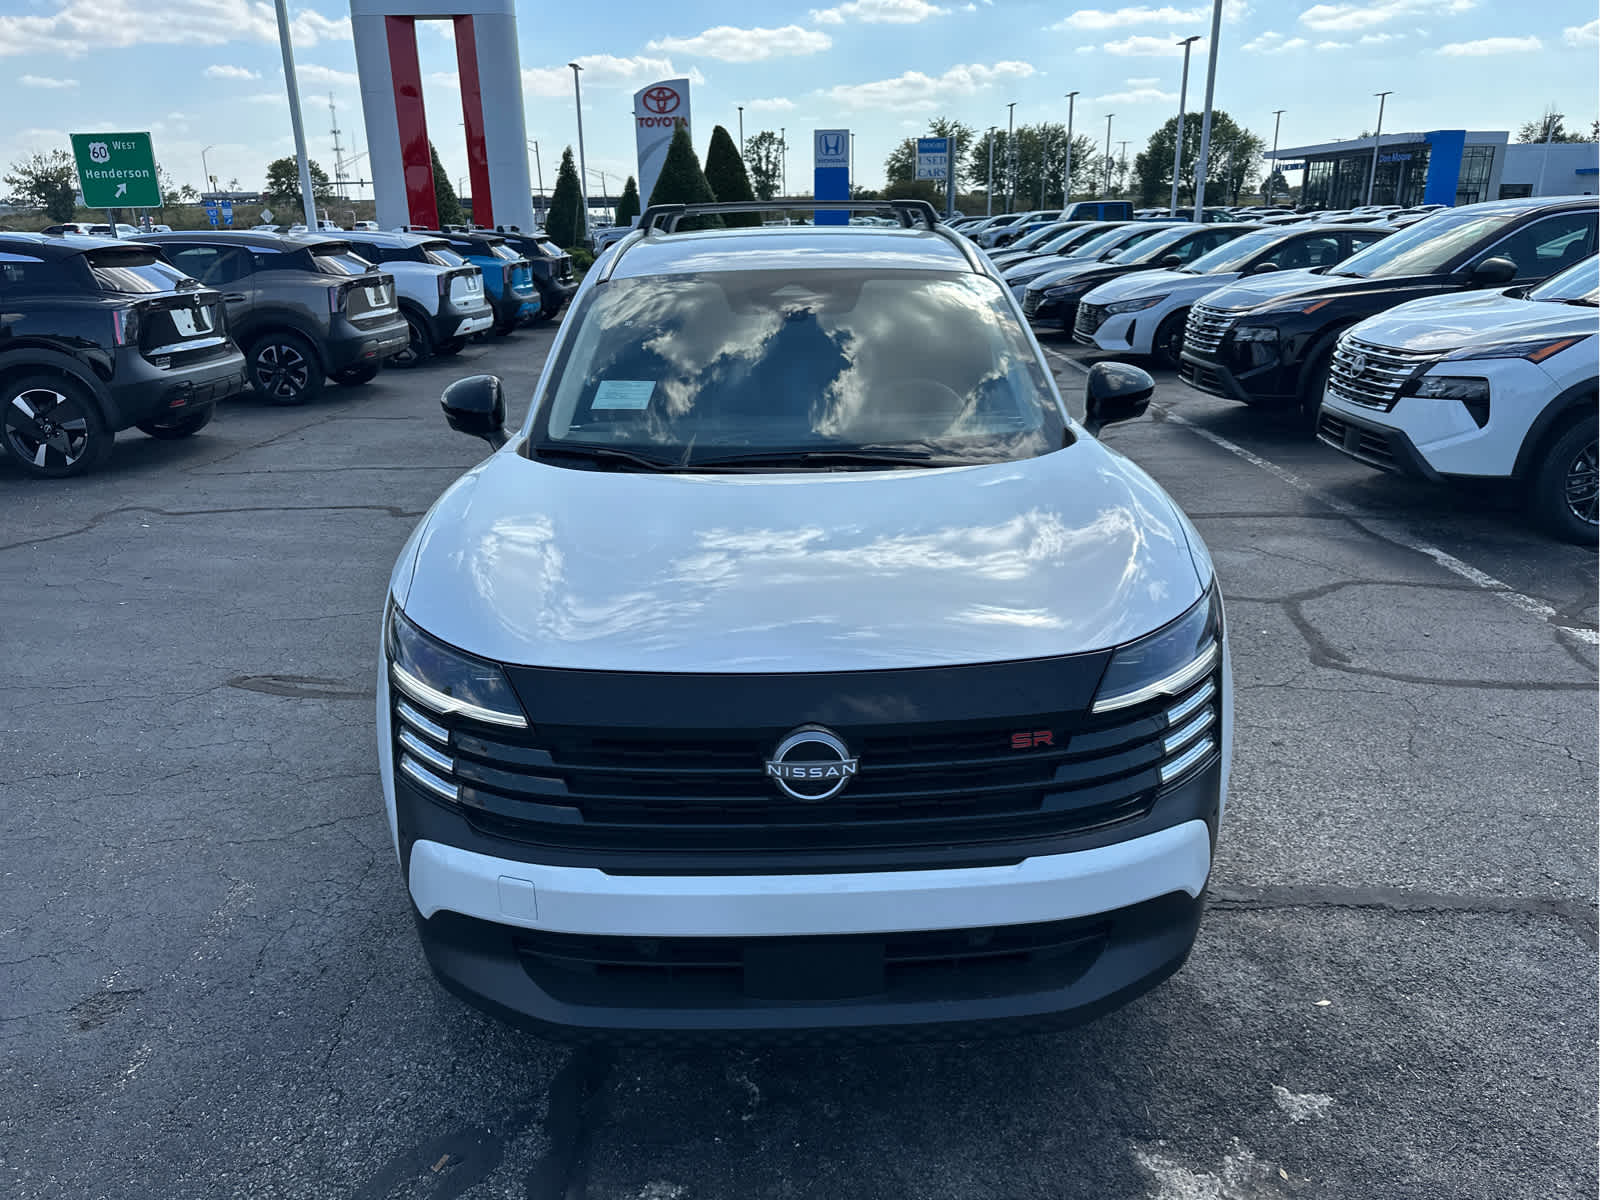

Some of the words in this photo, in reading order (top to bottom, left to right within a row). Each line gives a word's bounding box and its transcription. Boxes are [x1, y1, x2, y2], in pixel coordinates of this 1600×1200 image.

[637, 116, 689, 128] TOYOTA
[91, 146, 107, 159] 60
[918, 155, 947, 166] USED
[85, 168, 150, 179] Henderson
[918, 167, 946, 178] CARS
[1011, 730, 1055, 749] SR
[767, 763, 857, 778] NISSAN
